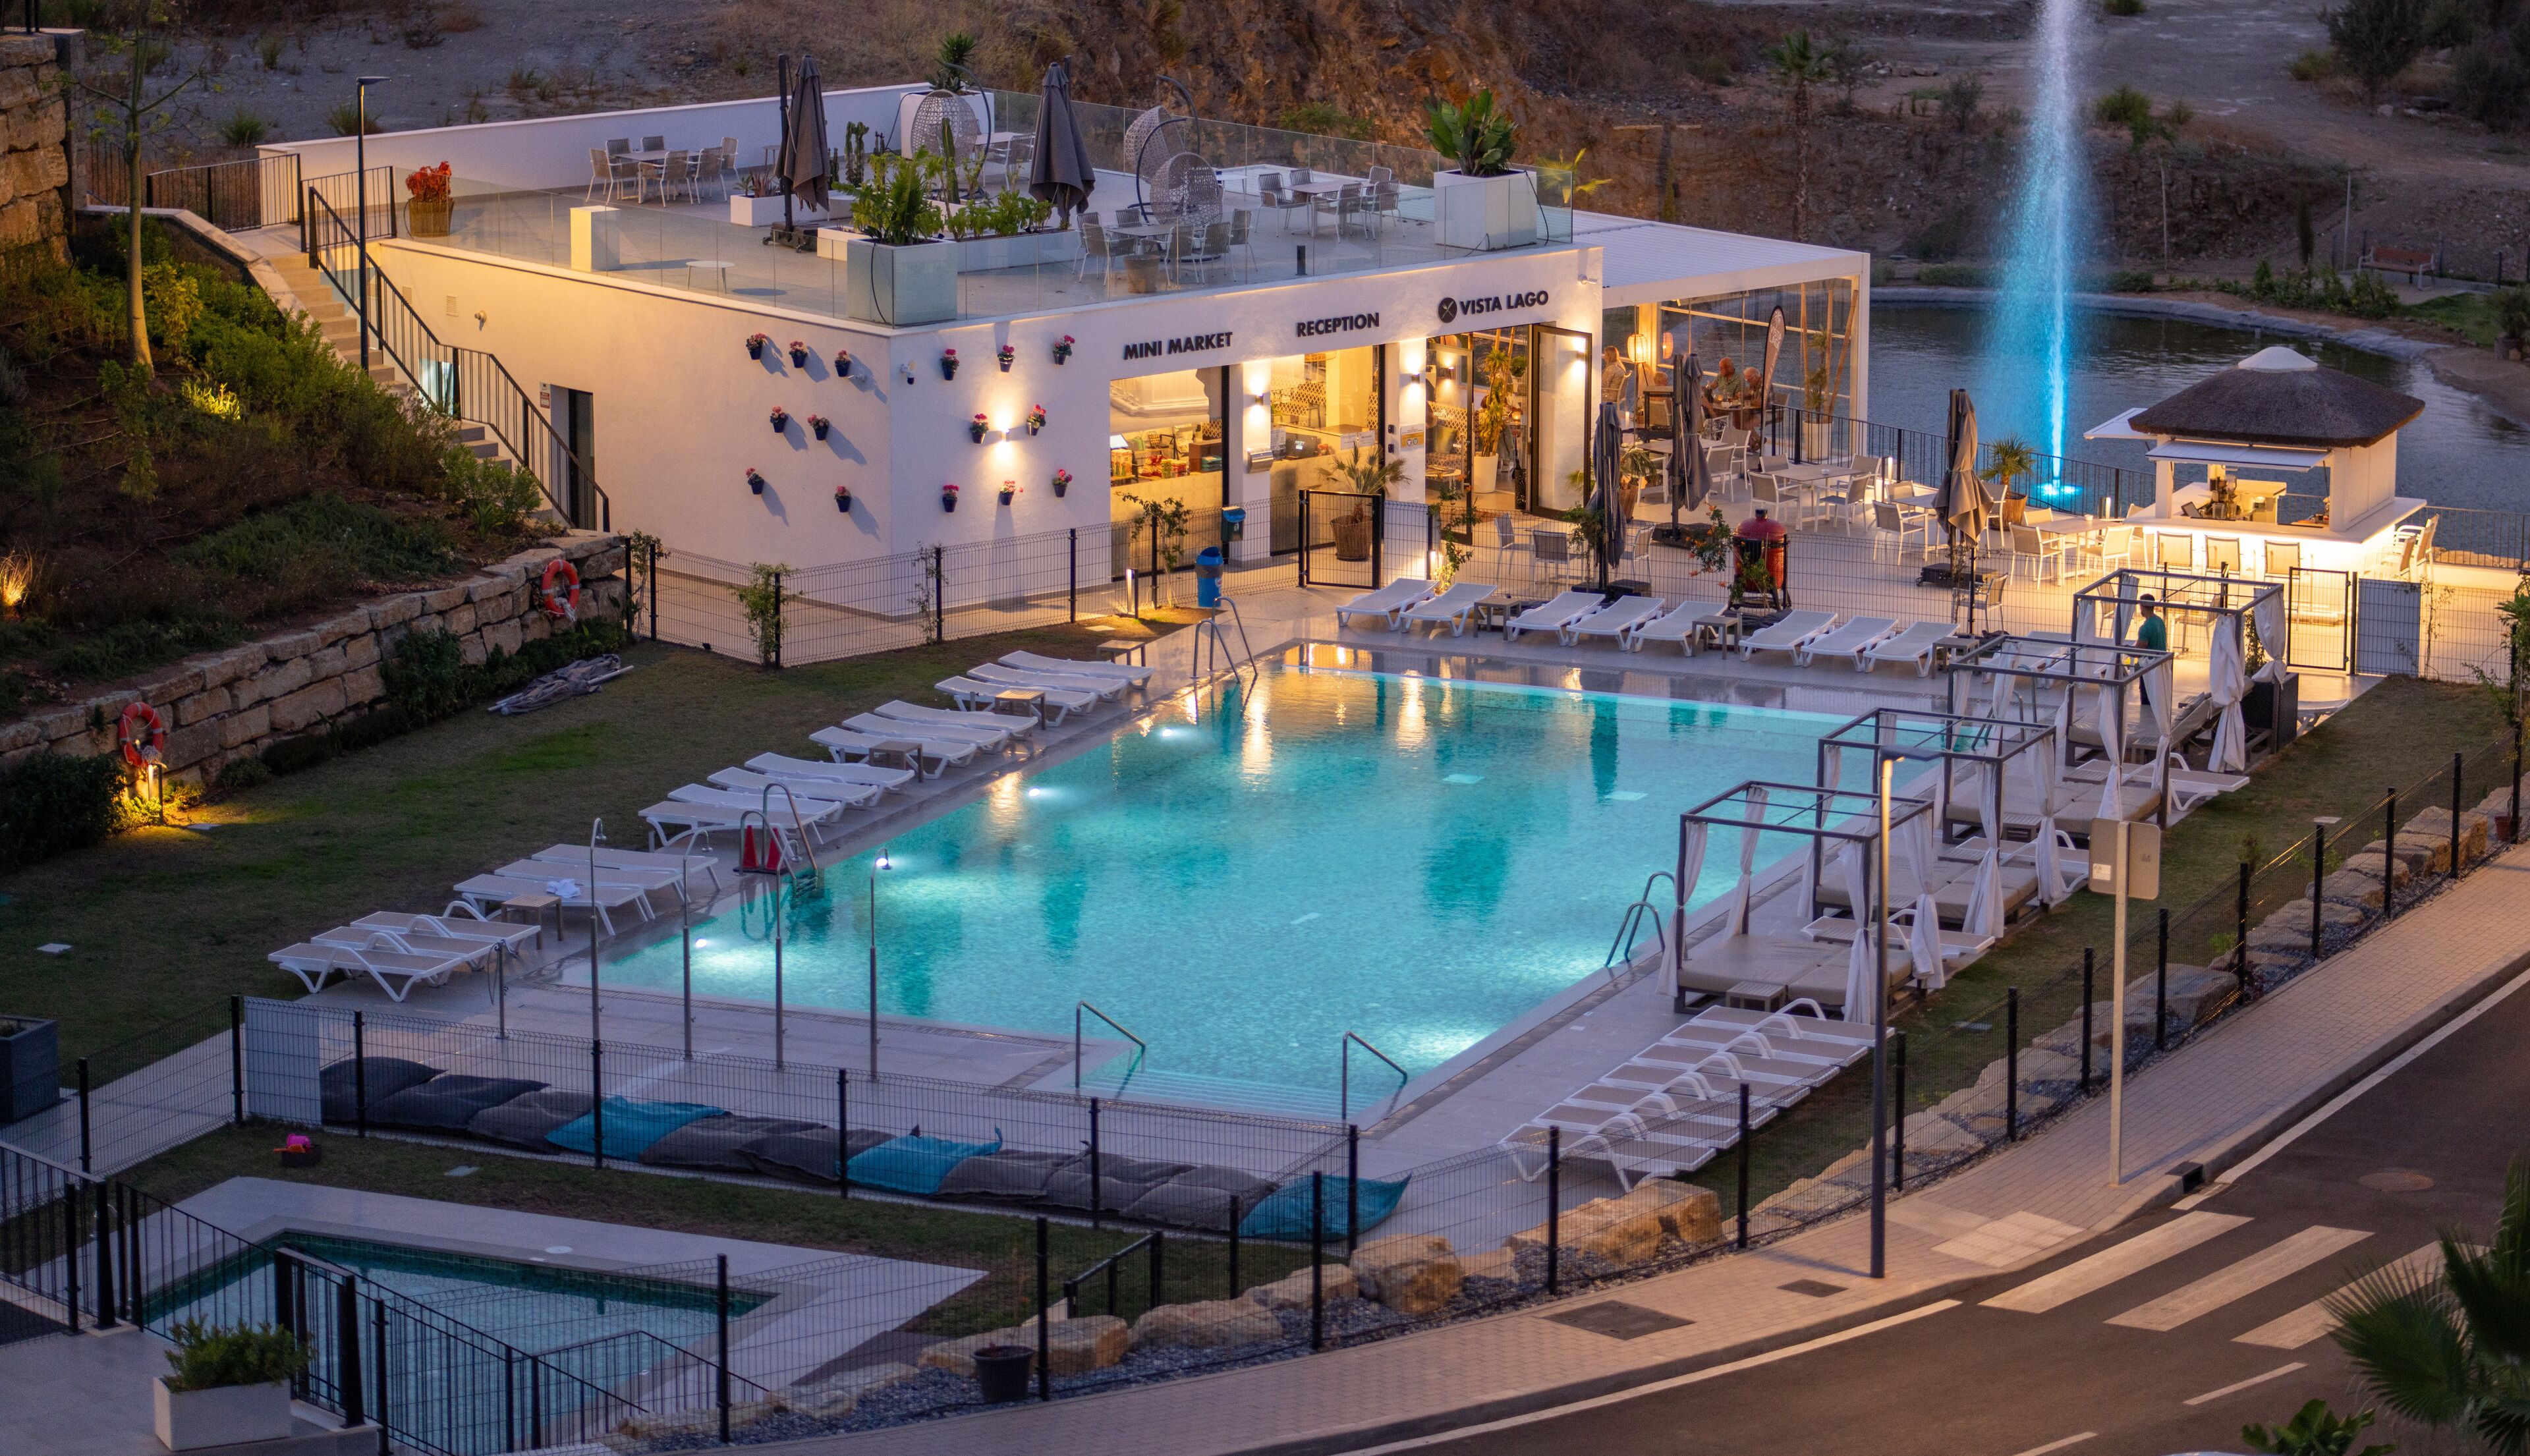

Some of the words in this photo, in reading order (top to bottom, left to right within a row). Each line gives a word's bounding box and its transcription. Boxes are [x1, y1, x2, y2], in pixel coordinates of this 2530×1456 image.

[1460, 296, 1502, 315] VISTA
[1506, 291, 1548, 309] LAGO
[1297, 312, 1380, 337] RECEPTION
[1124, 341, 1162, 360] MINI
[1168, 331, 1233, 354] MARKET
